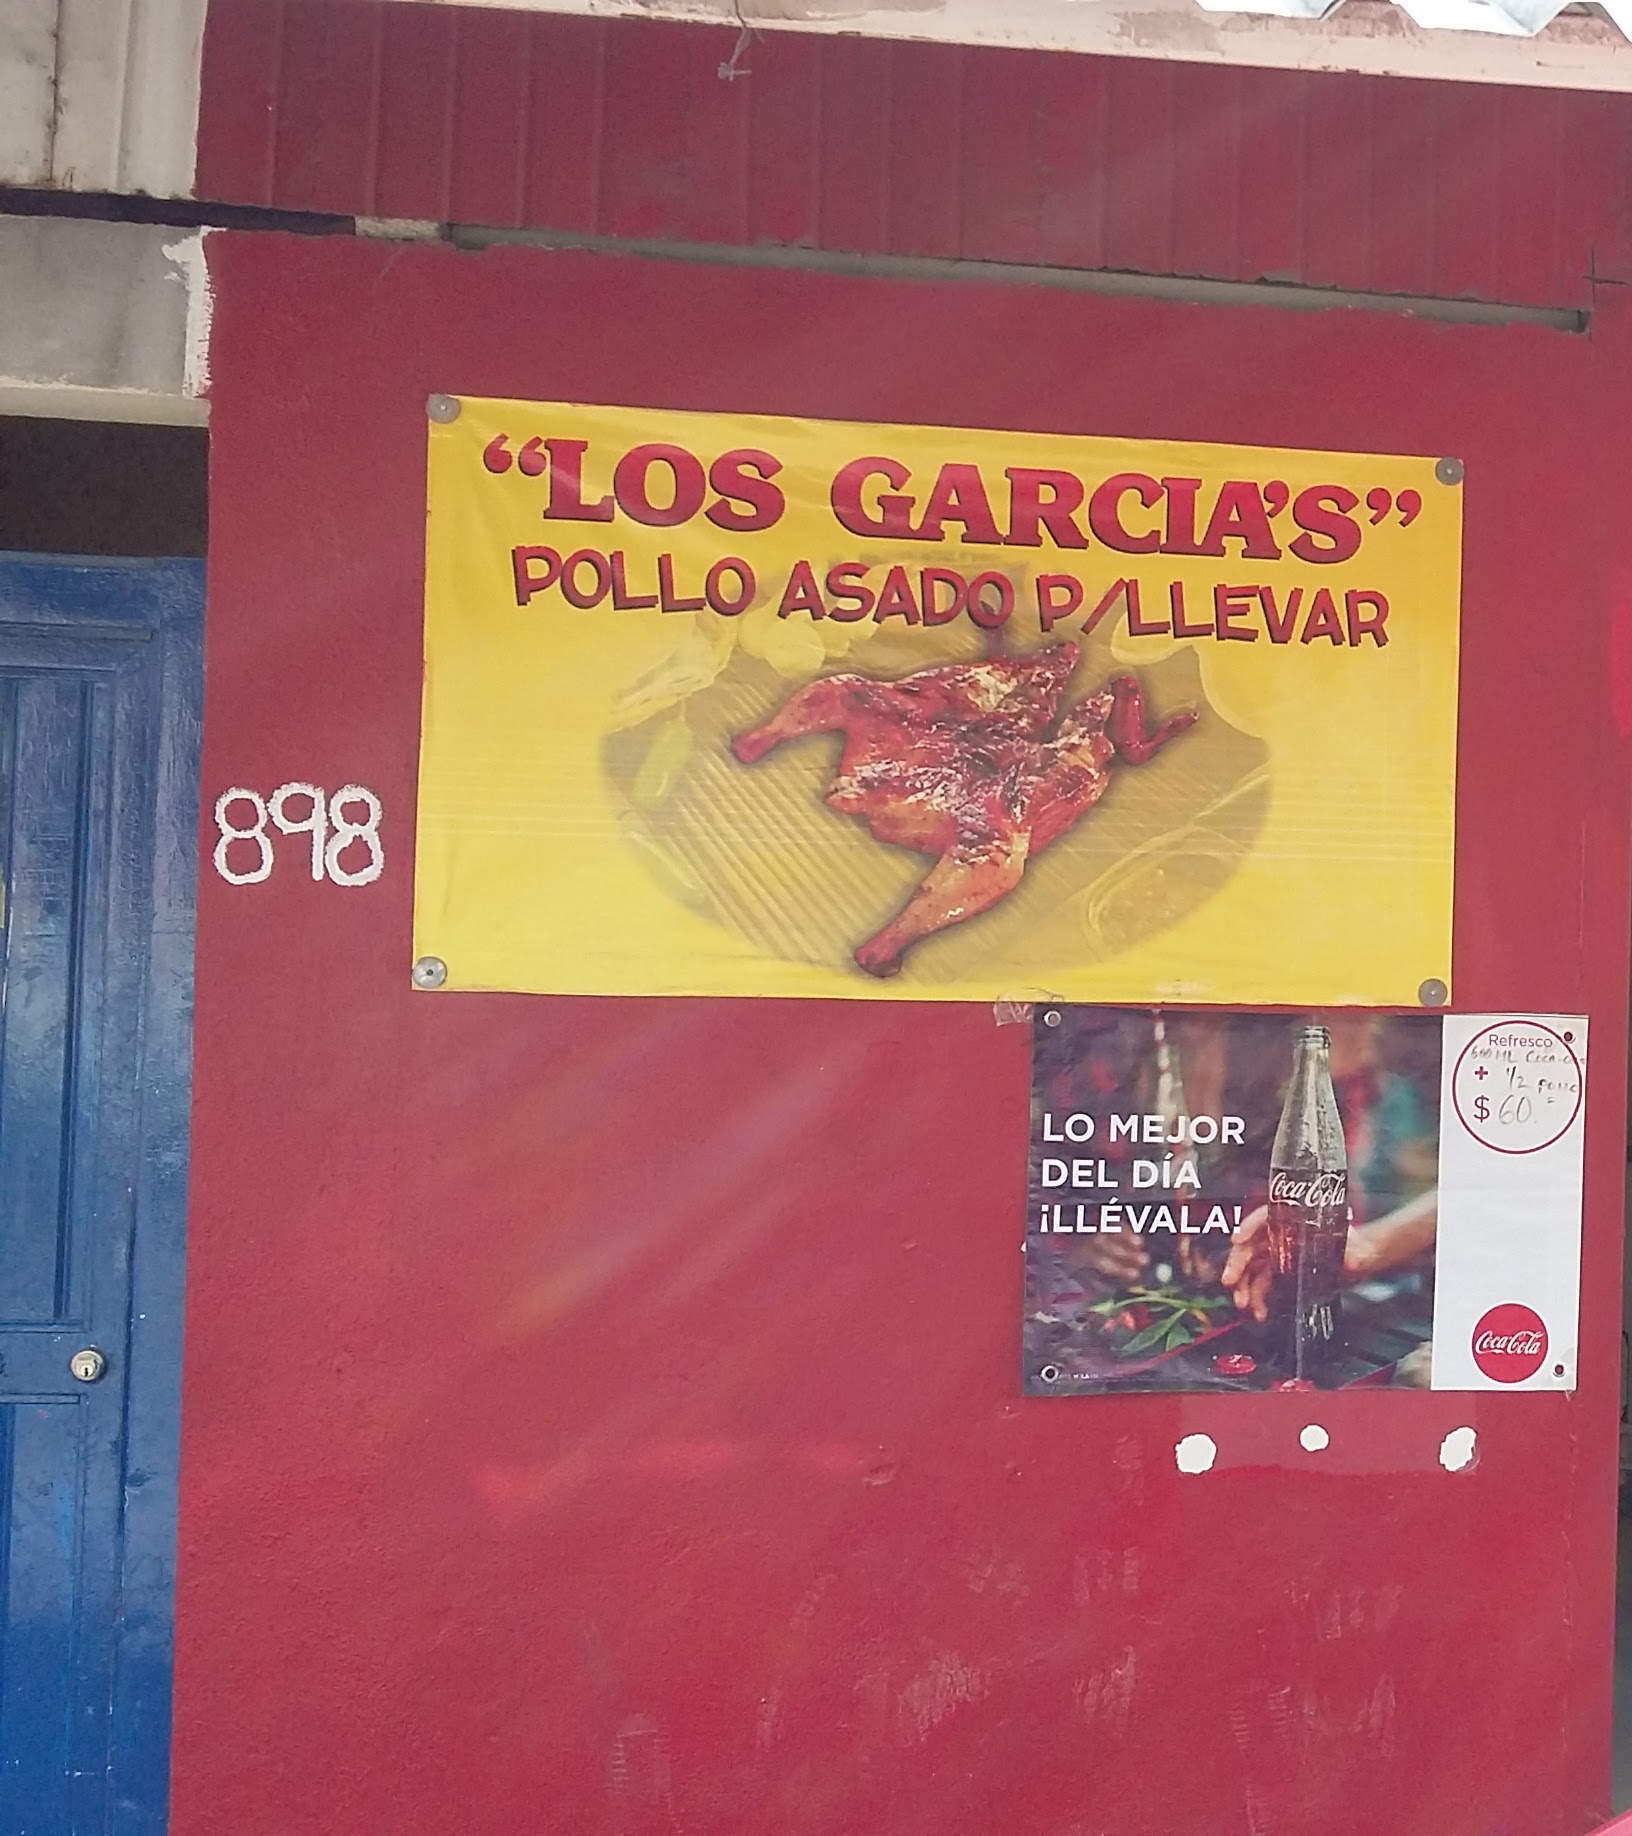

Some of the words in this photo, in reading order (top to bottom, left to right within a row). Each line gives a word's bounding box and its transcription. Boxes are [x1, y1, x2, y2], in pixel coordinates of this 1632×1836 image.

[512, 544, 755, 616] POLLO
[780, 559, 1014, 631] ASADO
[1038, 572, 1391, 648] P/LLEVAR
[213, 782, 385, 887] 898
[1488, 1034, 1553, 1048] Refresco
[1043, 1112, 1095, 1144] LO
[1110, 1113, 1245, 1146] MEJOR
[1041, 1160, 1118, 1189] DEL
[1132, 1151, 1201, 1190] DÍA
[1270, 1172, 1346, 1207] Coca-Cola
[1039, 1198, 1242, 1235] ¡LLÉVALA!
[1475, 1330, 1544, 1354] Coca-Cola
